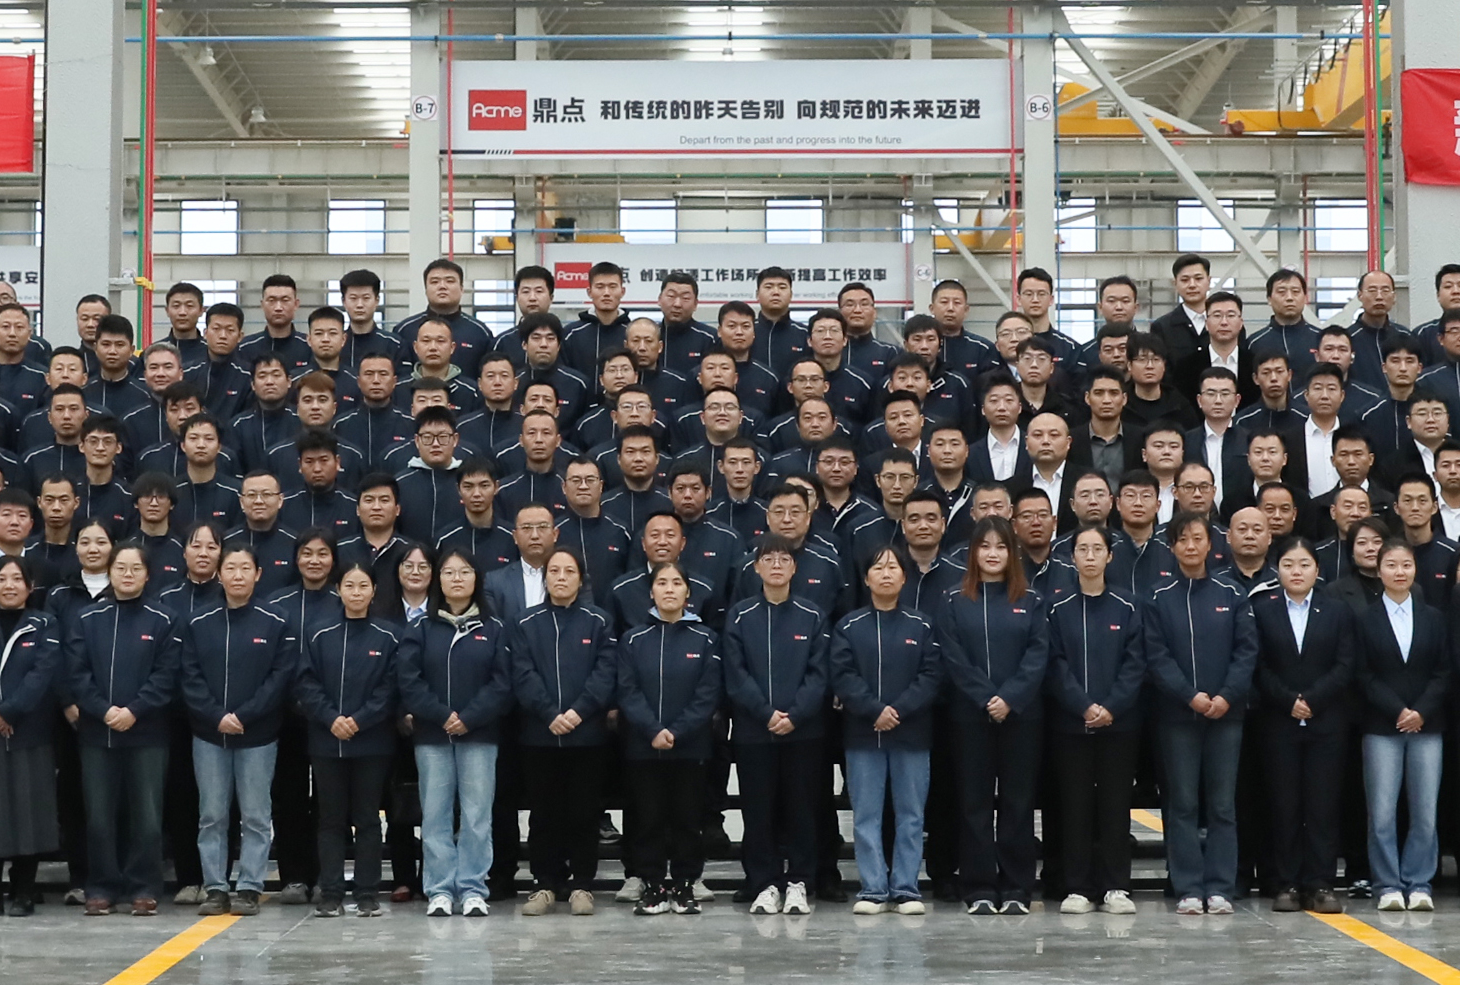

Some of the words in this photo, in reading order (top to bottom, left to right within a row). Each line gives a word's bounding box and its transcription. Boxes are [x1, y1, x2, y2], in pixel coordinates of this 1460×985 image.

[415, 102, 435, 114] B-7
[472, 102, 523, 118] Acme
[532, 96, 586, 124] 鼎点
[600, 99, 785, 120] 和传统的昨天告别
[797, 98, 981, 120] 向规范的未来迈进
[1029, 101, 1049, 114] B-6
[679, 135, 711, 146] Depart
[712, 135, 735, 145] from
[736, 135, 752, 145] the
[753, 136, 774, 146] past
[775, 135, 794, 145] and
[795, 136, 837, 147] progress
[838, 135, 856, 145] into
[857, 135, 873, 145] the
[784, 268, 887, 285] 提高工作效率
